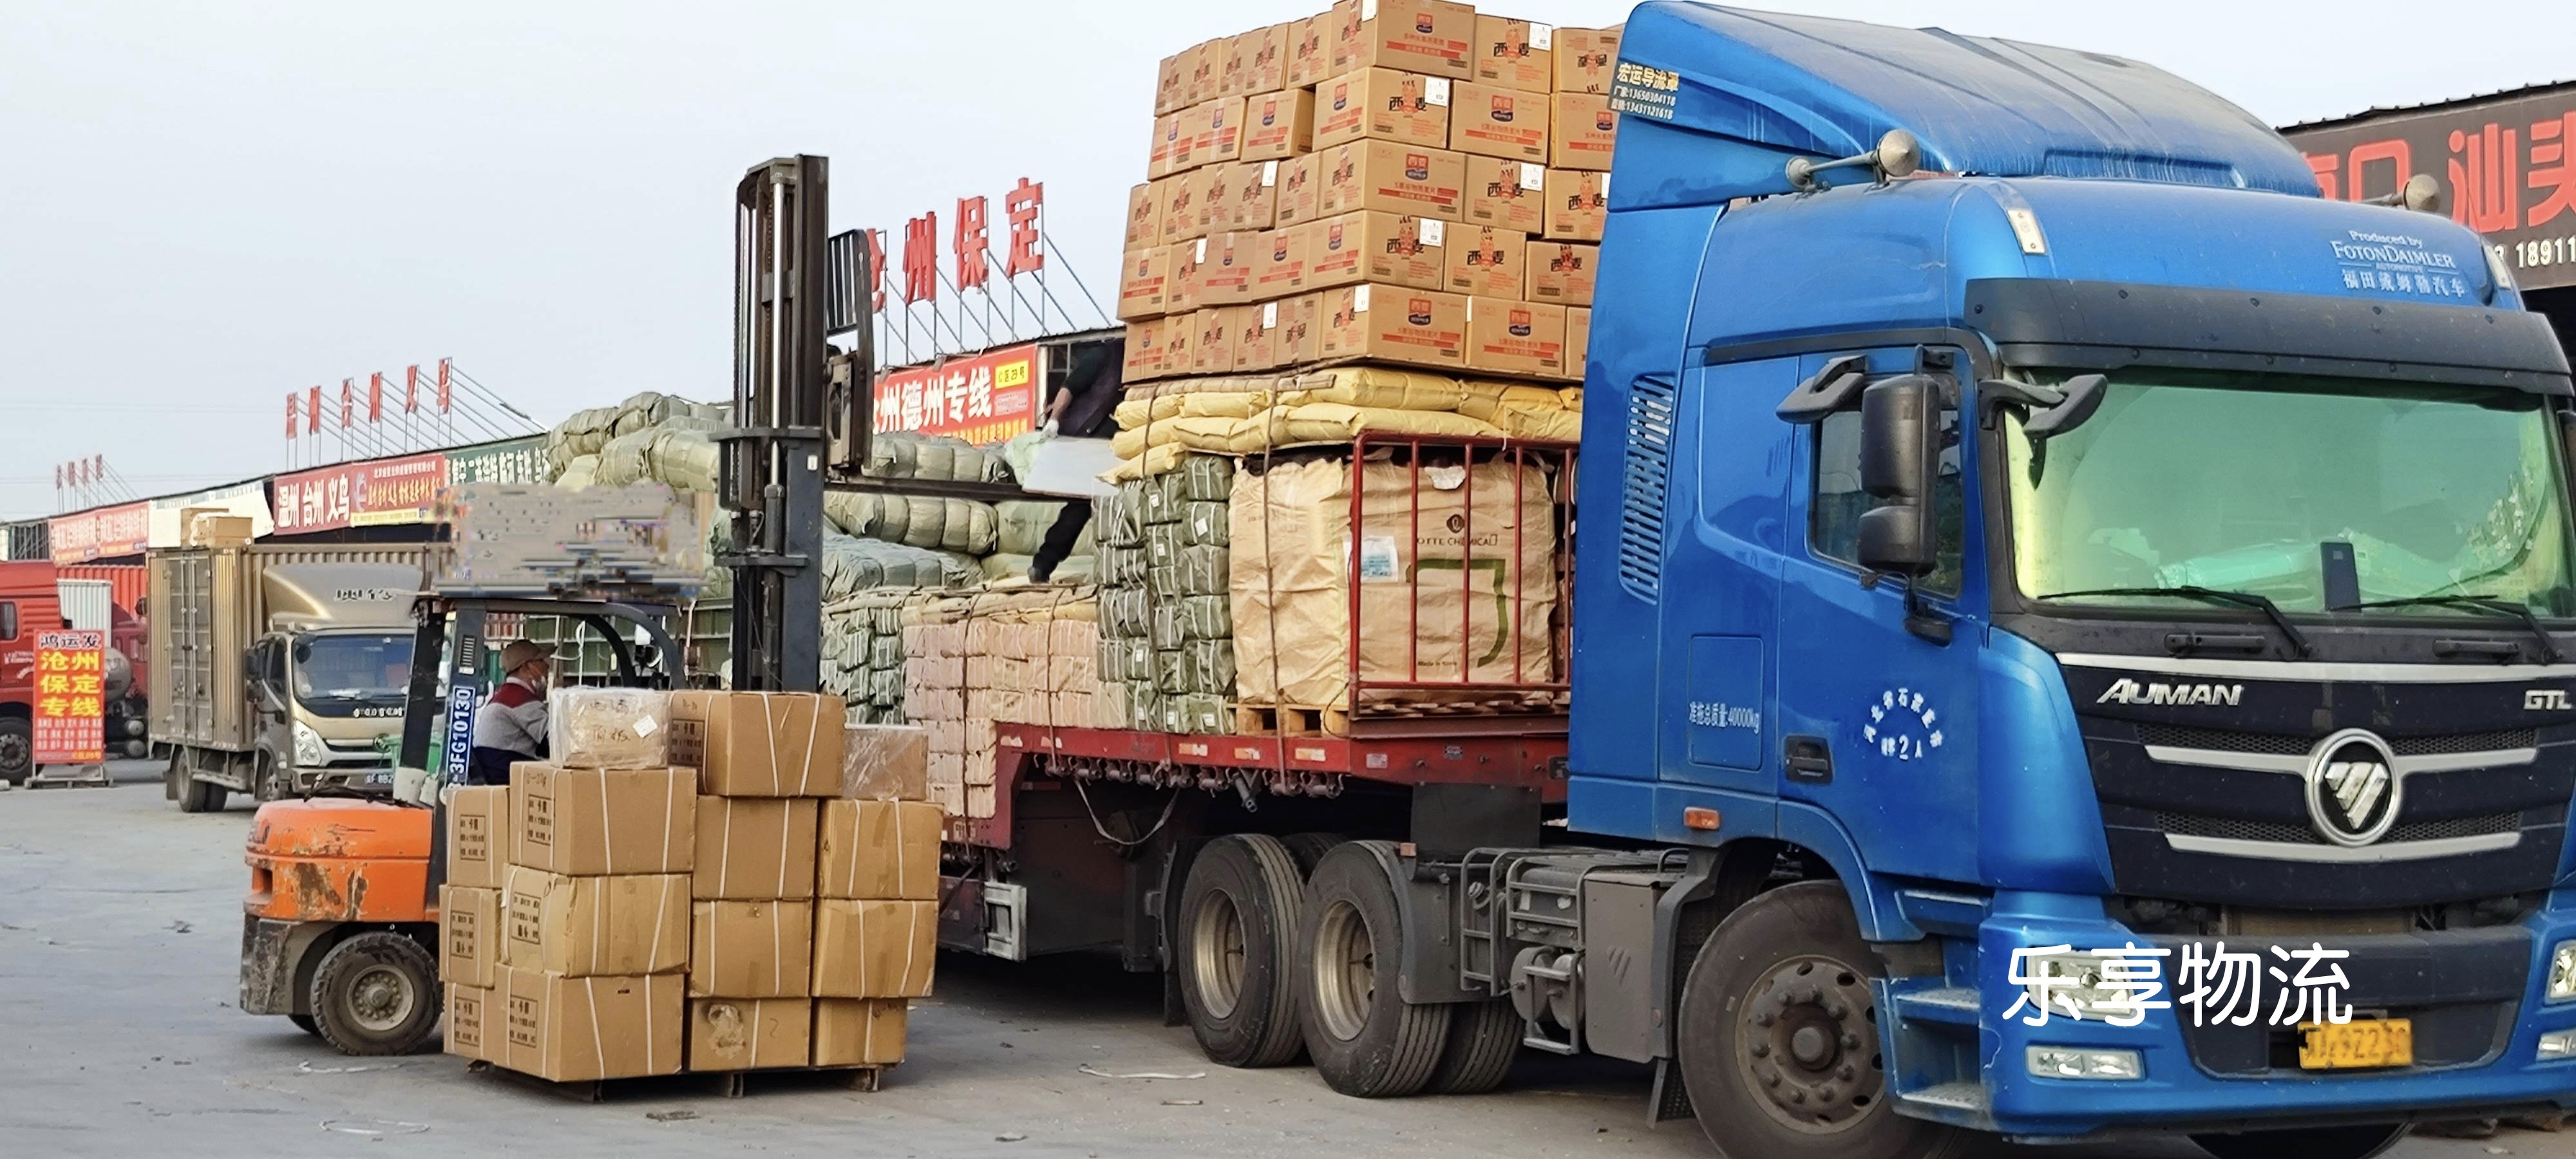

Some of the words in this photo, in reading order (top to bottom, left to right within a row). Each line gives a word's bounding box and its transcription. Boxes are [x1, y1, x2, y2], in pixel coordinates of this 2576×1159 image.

[2349, 231, 2406, 245] Produced
[2407, 236, 2423, 249] by
[2342, 269, 2465, 297] 福田戴姆勒汽车
[873, 366, 991, 435] 州德州专线
[278, 483, 299, 527] 温州
[303, 479, 324, 527] 台州
[327, 473, 350, 523] 义乌
[1416, 538, 1443, 546] OTTE
[41, 634, 100, 648] 鸿运发
[41, 651, 100, 671] 沧州
[40, 674, 101, 694] 保定
[2097, 678, 2244, 706] AUMAN
[39, 697, 101, 717] 专线
[2524, 690, 2572, 710] GTL
[449, 690, 471, 787] -3FG10130
